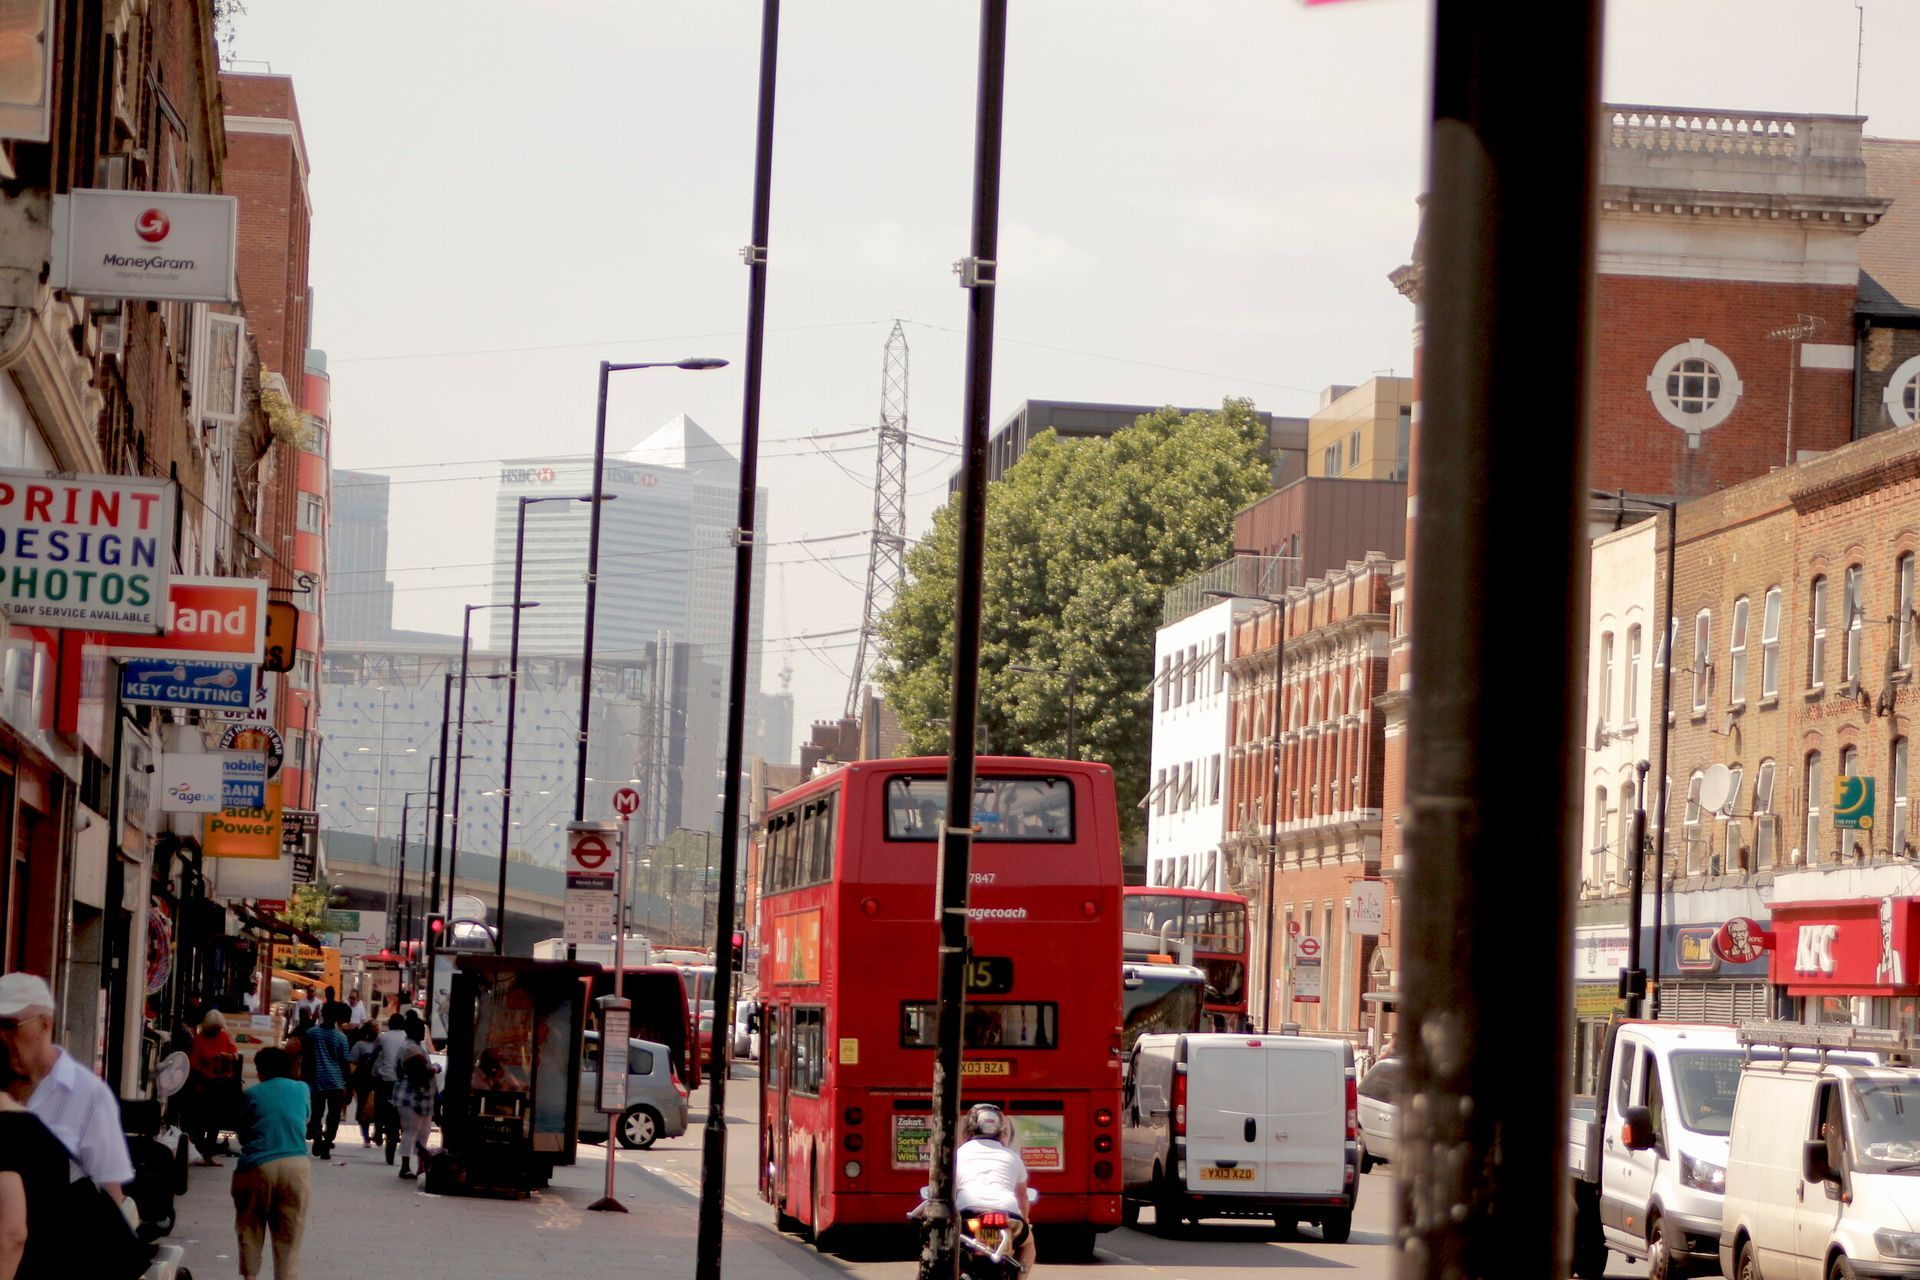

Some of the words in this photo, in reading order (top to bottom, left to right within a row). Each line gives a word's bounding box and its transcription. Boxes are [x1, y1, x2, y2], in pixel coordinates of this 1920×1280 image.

[103, 254, 195, 270] MoneyGram
[501, 468, 536, 483] HSBC
[607, 467, 640, 485] HSBC
[0, 527, 157, 568] ESIGN
[0, 565, 150, 607] HOTOS
[14, 604, 35, 614] DAY
[38, 606, 86, 618] SERVICE
[90, 610, 150, 622] AVAILABLE
[127, 683, 161, 697] KEY
[166, 686, 243, 703] CUTTING
[178, 793, 201, 804] age
[203, 793, 217, 801] UK
[616, 793, 636, 811] M
[210, 819, 274, 835] Power
[1290, 923, 1297, 934] L
[1794, 925, 1839, 972] KFC
[984, 1062, 1005, 1074] BZA
[897, 1153, 918, 1162] With
[1208, 1169, 1230, 1179] YX13
